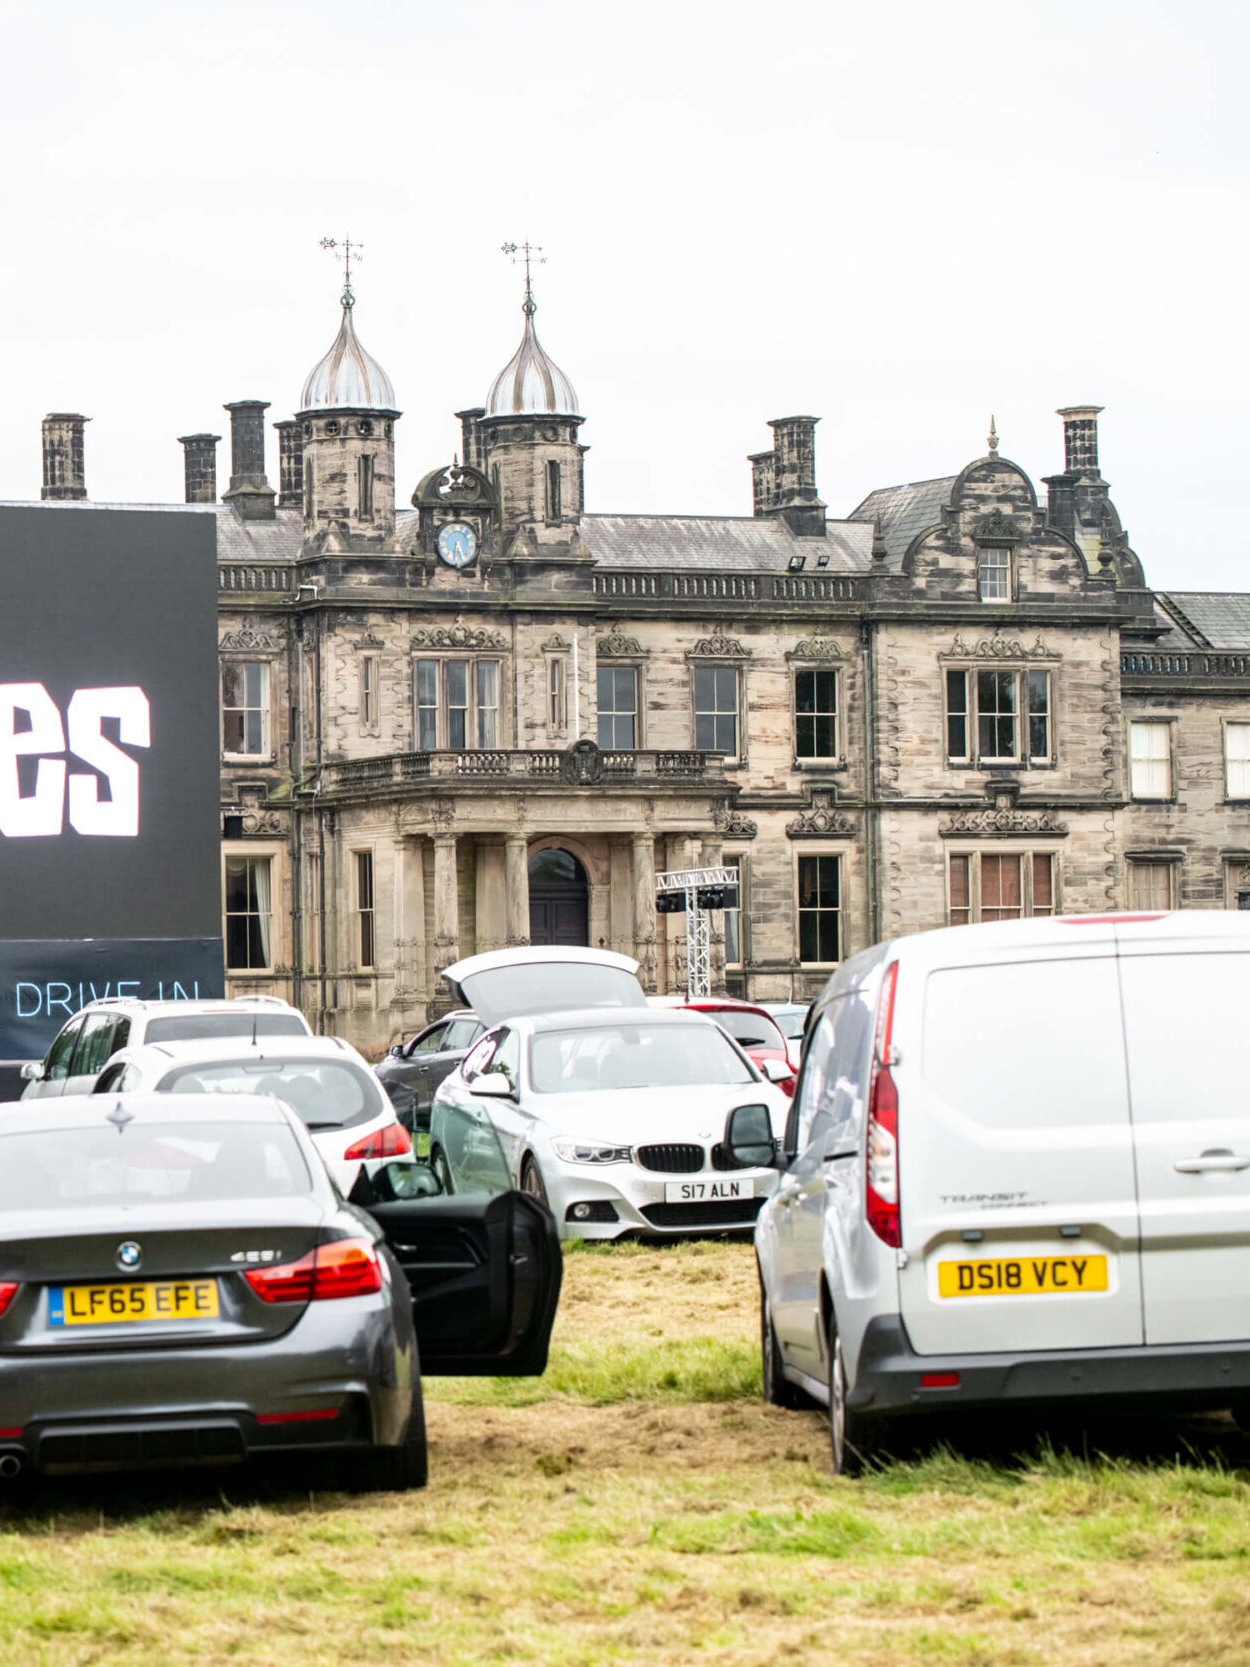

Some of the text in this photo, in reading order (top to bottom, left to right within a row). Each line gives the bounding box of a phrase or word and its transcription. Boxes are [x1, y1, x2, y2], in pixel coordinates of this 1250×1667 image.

[681, 1182, 740, 1199] S17 ALN
[957, 1259, 1088, 1291] DS18 VCY
[70, 1284, 211, 1317] LF65 EFE
